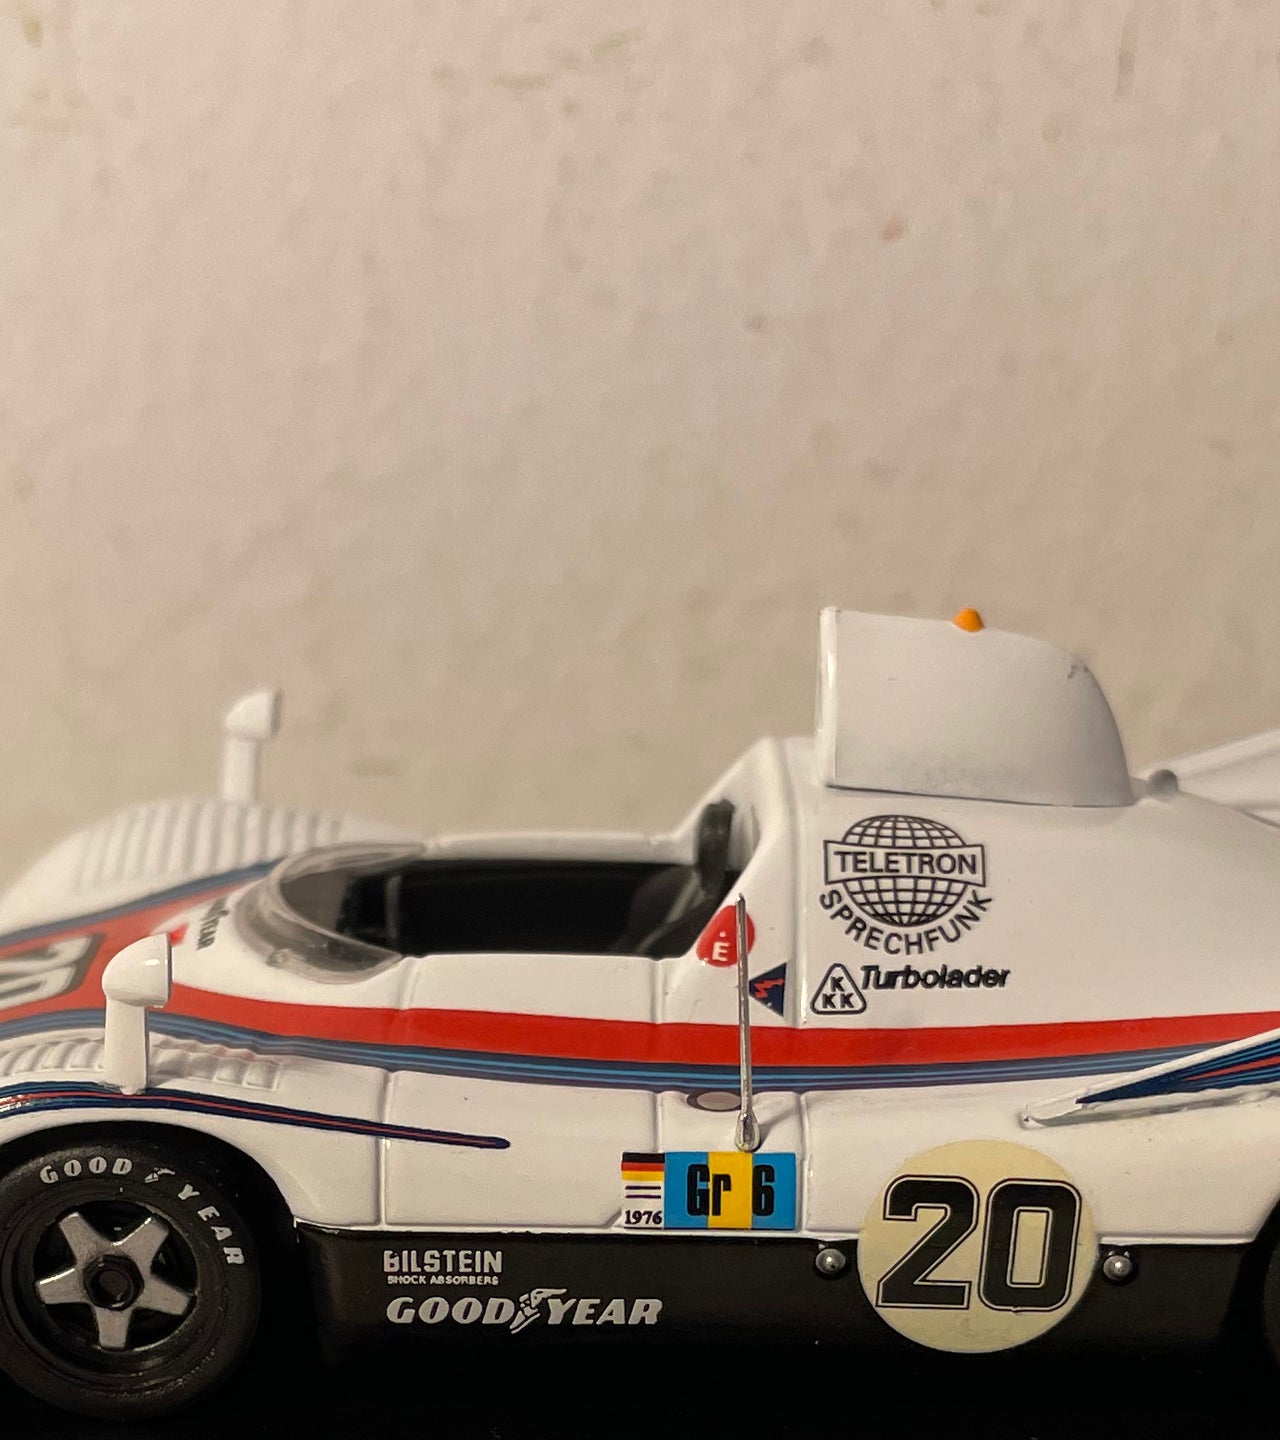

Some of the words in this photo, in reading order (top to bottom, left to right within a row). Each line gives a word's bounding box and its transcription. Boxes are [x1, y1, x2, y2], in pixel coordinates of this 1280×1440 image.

[832, 850, 977, 875] TELETRON
[819, 888, 994, 956] SPRECHFUNK
[860, 964, 1012, 991] Turbolader
[687, 1164, 732, 1216] Gr
[753, 1164, 776, 1216] 6
[624, 1209, 663, 1226] 1976
[875, 1173, 1082, 1313] 20
[383, 1249, 503, 1274] BILSTEIN
[386, 1274, 427, 1286] SHOCK
[429, 1274, 500, 1286] ABSORBERS
